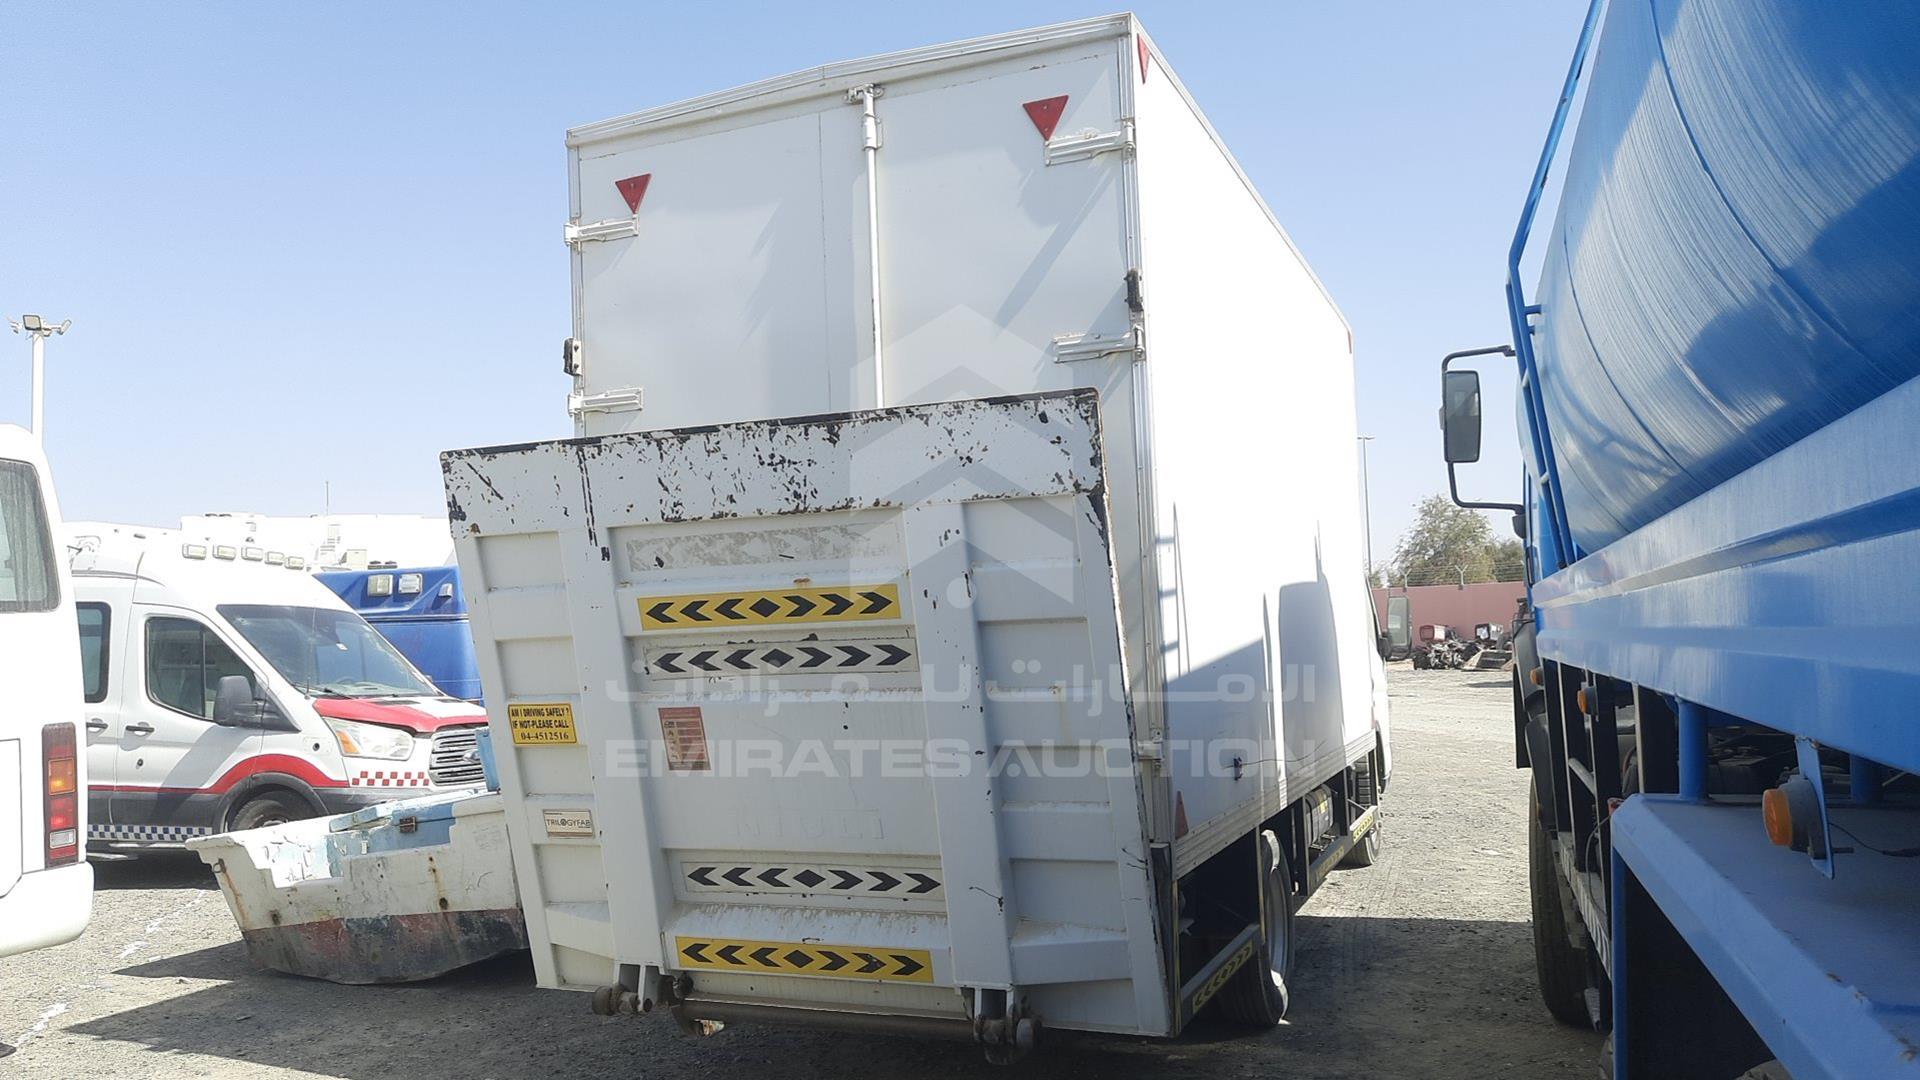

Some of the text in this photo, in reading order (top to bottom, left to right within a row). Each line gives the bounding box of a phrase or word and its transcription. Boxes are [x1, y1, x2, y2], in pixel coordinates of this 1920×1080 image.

[511, 708, 519, 717] AM
[523, 708, 545, 717] DRIVING
[546, 708, 565, 717] SAFELY
[513, 719, 518, 729] IF
[554, 719, 569, 729] CALL
[521, 731, 569, 740] 04-4512516
